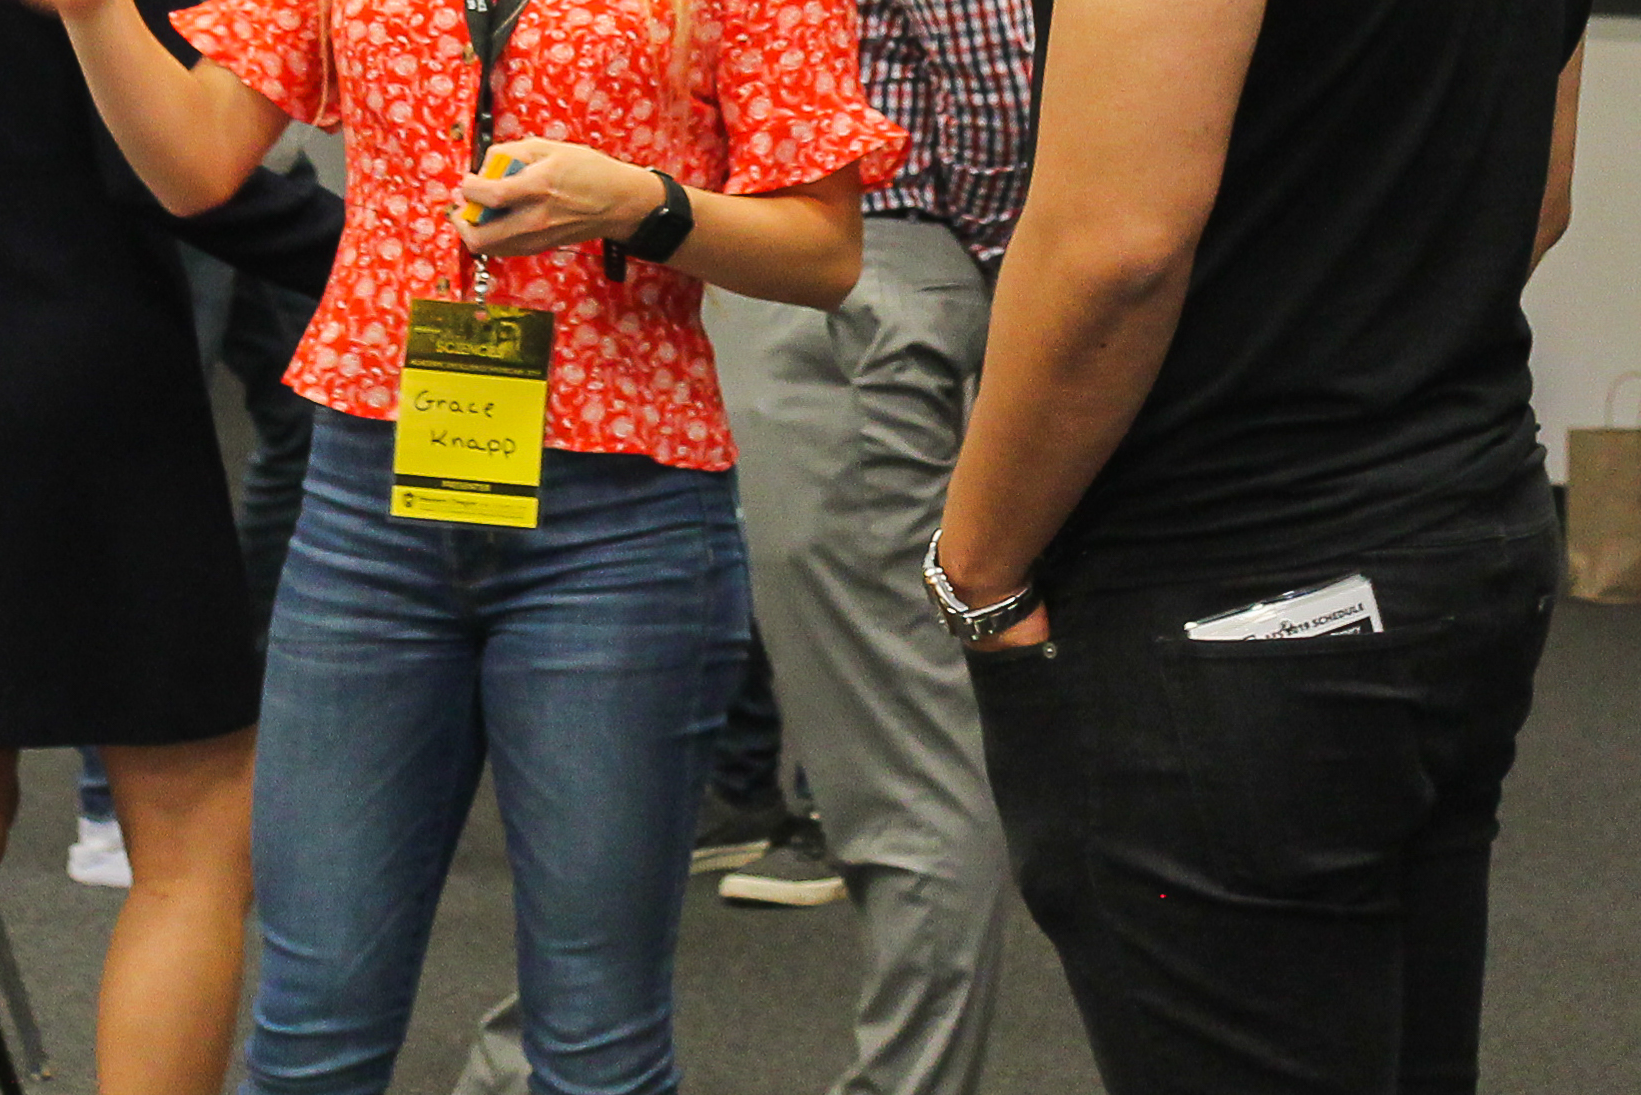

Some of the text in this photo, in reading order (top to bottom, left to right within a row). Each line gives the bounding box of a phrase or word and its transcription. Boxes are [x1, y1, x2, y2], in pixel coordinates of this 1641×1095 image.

[414, 390, 496, 418] Grace
[430, 429, 517, 458] Knapp
[1311, 602, 1364, 627] SCHEDULE
